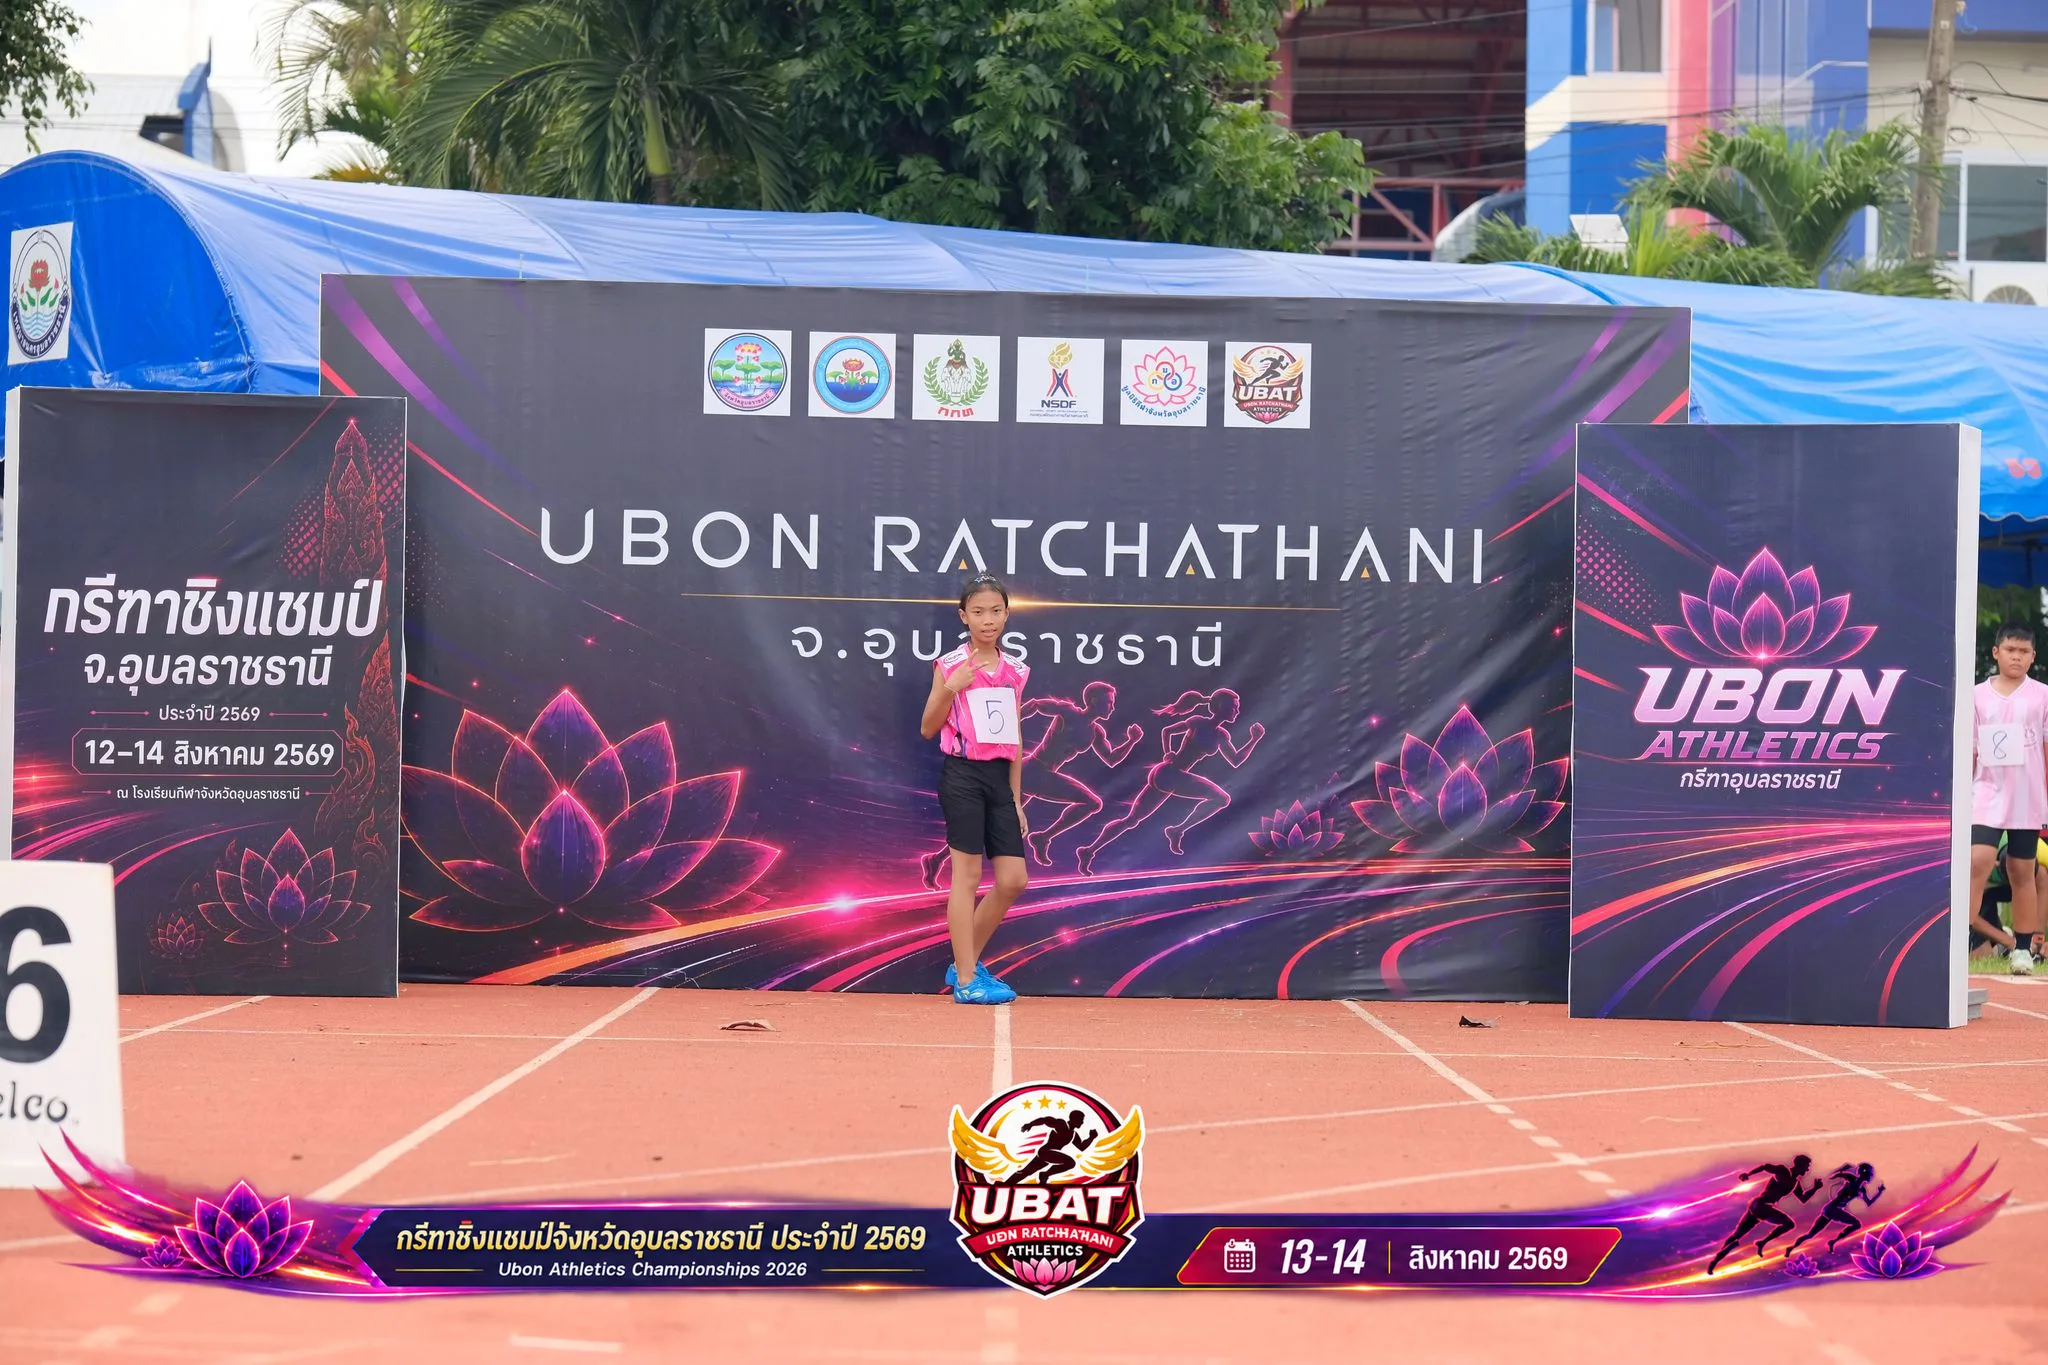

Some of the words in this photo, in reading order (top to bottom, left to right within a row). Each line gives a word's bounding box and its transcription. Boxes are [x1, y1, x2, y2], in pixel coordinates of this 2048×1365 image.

[1041, 399, 1077, 409] NSDF
[1239, 386, 1298, 402] UBAT
[540, 507, 819, 570] UBON
[873, 515, 1483, 585] RATCHATHANI
[43, 573, 383, 637] กรีฑาชิงแชมป์
[791, 621, 1222, 677] จ.อุบราชธานี
[84, 645, 334, 697] จ.อุบลราชธานี
[1634, 667, 1908, 725] UBON
[159, 704, 215, 721] ประจำปี
[220, 706, 261, 722] 2569
[985, 700, 1005, 735] 5
[174, 740, 265, 766] สิงหาคม
[274, 743, 335, 766] 2569
[1636, 730, 1895, 761] ATHLETICS
[1992, 729, 2008, 760] 8
[116, 788, 129, 800] ณ
[132, 785, 301, 804] โรงเรียนกีฬาจังหวัดอุบลราชธานี
[1680, 767, 1843, 794] กรีฑาอุบลราชธานี
[0, 905, 73, 1065] 6
